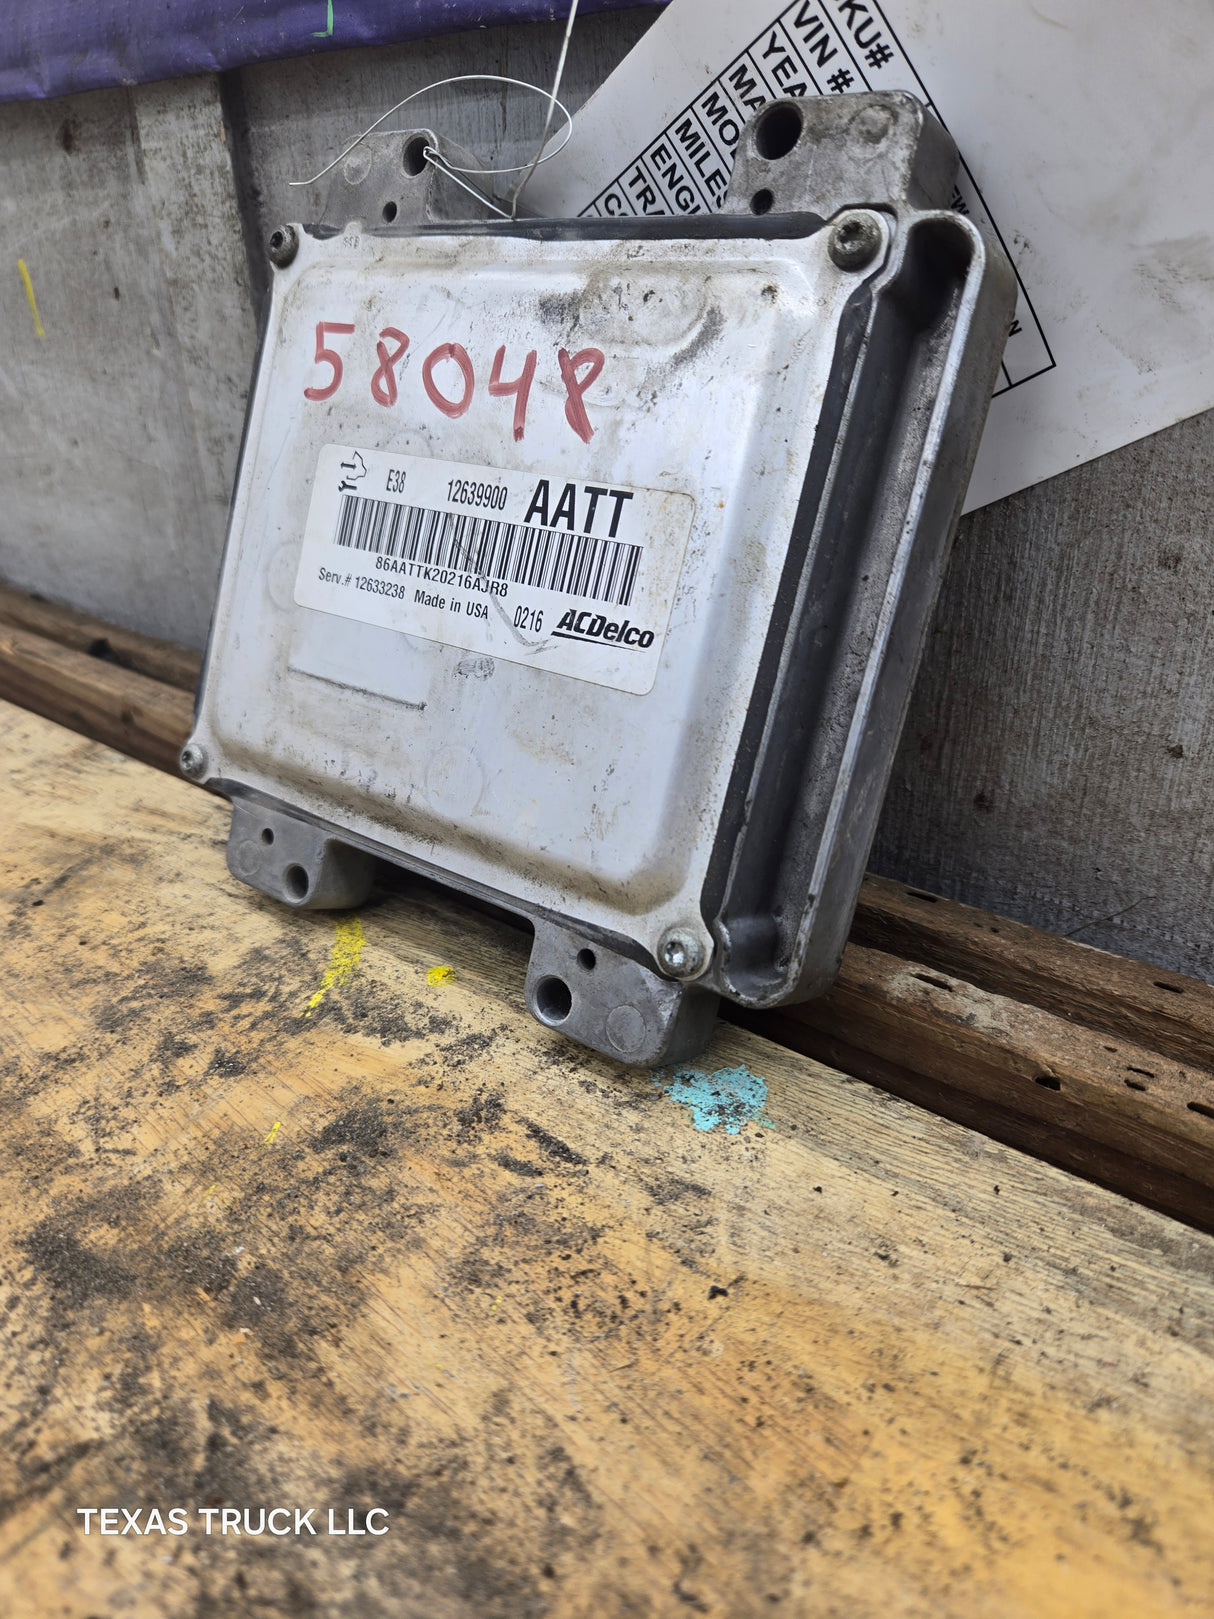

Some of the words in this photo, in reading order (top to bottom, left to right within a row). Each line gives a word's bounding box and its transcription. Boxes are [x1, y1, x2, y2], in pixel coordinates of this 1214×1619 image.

[793, 0, 838, 68] VIN
[826, 68, 855, 94] #
[834, 0, 894, 69] KU#
[701, 91, 740, 160] MO
[604, 193, 629, 216] C
[386, 468, 406, 493] E38
[446, 479, 508, 511] 12639900
[523, 479, 634, 538] AATT
[354, 576, 406, 600] 12633238
[414, 589, 446, 610] Made
[450, 596, 462, 613] in
[466, 601, 489, 620] USA
[375, 555, 509, 598] 86AATTK20216AJR8
[513, 605, 544, 633] 0216
[554, 608, 655, 649] ACDelco
